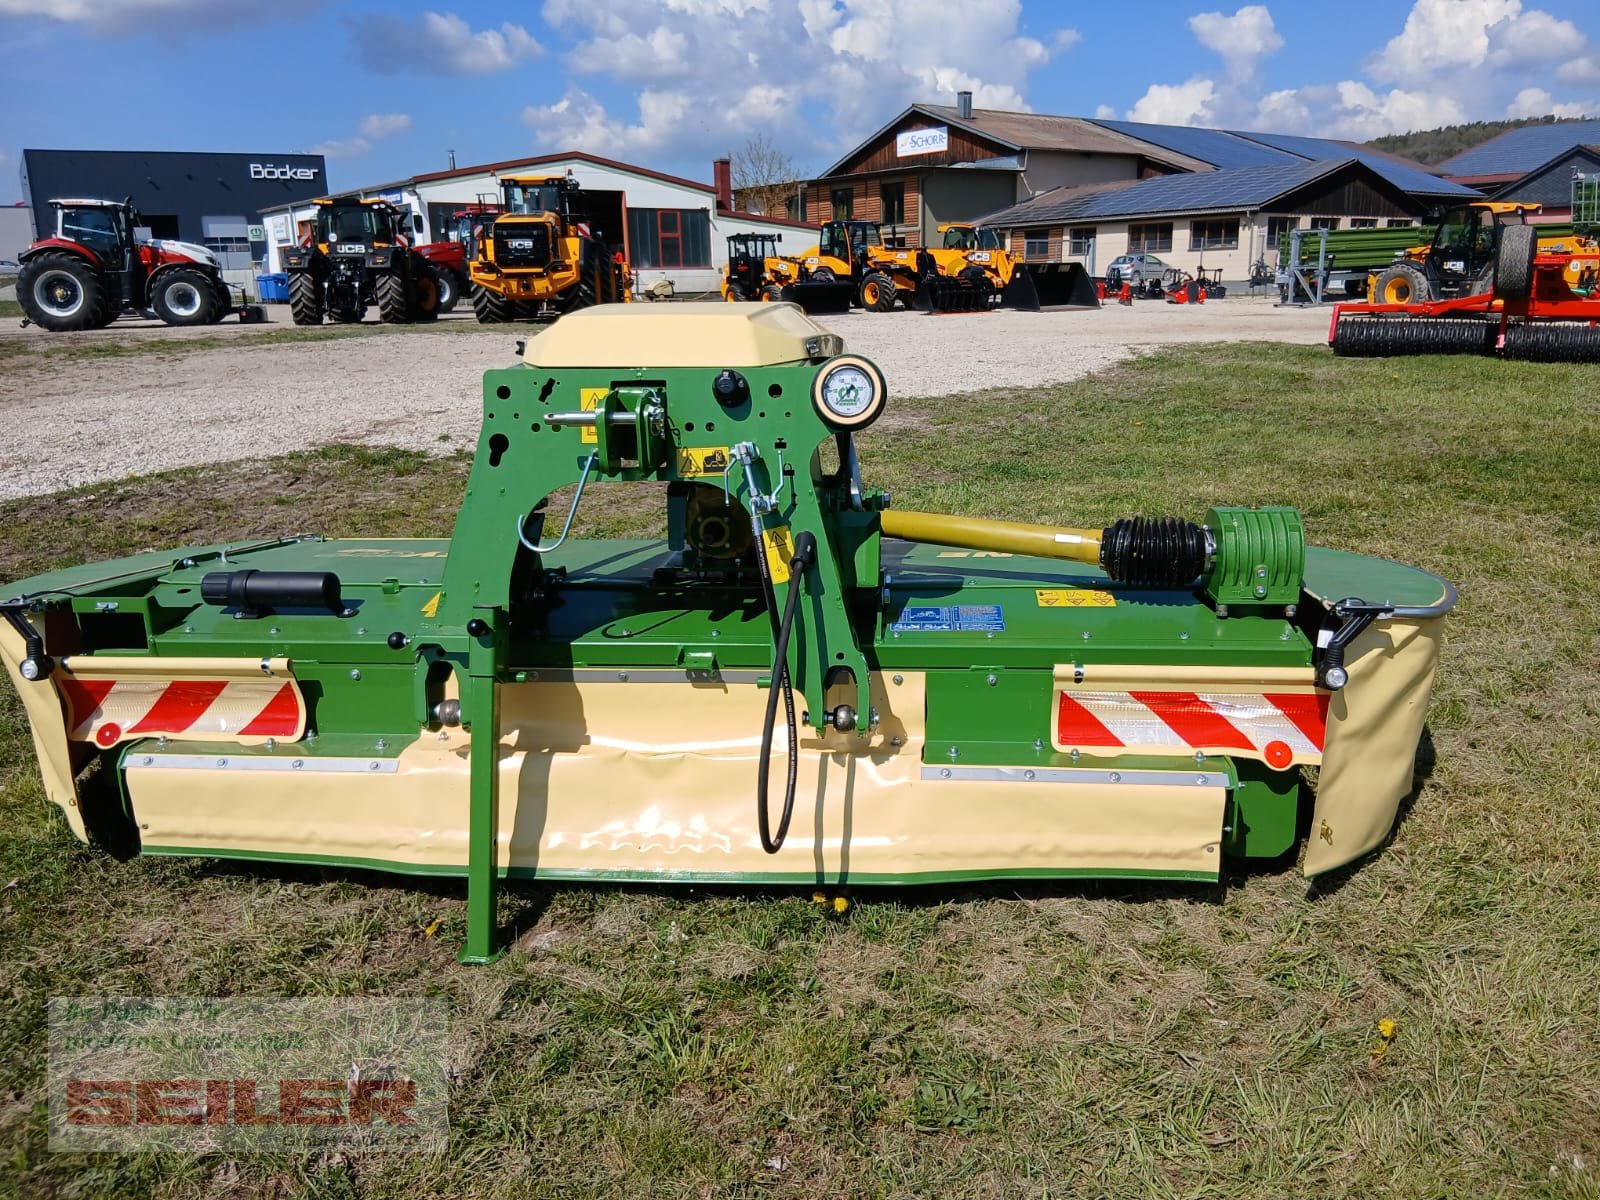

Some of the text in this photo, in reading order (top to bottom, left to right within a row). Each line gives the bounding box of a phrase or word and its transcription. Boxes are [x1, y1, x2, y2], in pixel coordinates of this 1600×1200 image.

[250, 163, 319, 180] Böcker
[336, 244, 366, 254] JCB
[508, 240, 533, 249] JCB
[967, 251, 990, 262] JCB
[1443, 260, 1465, 271] JCB
